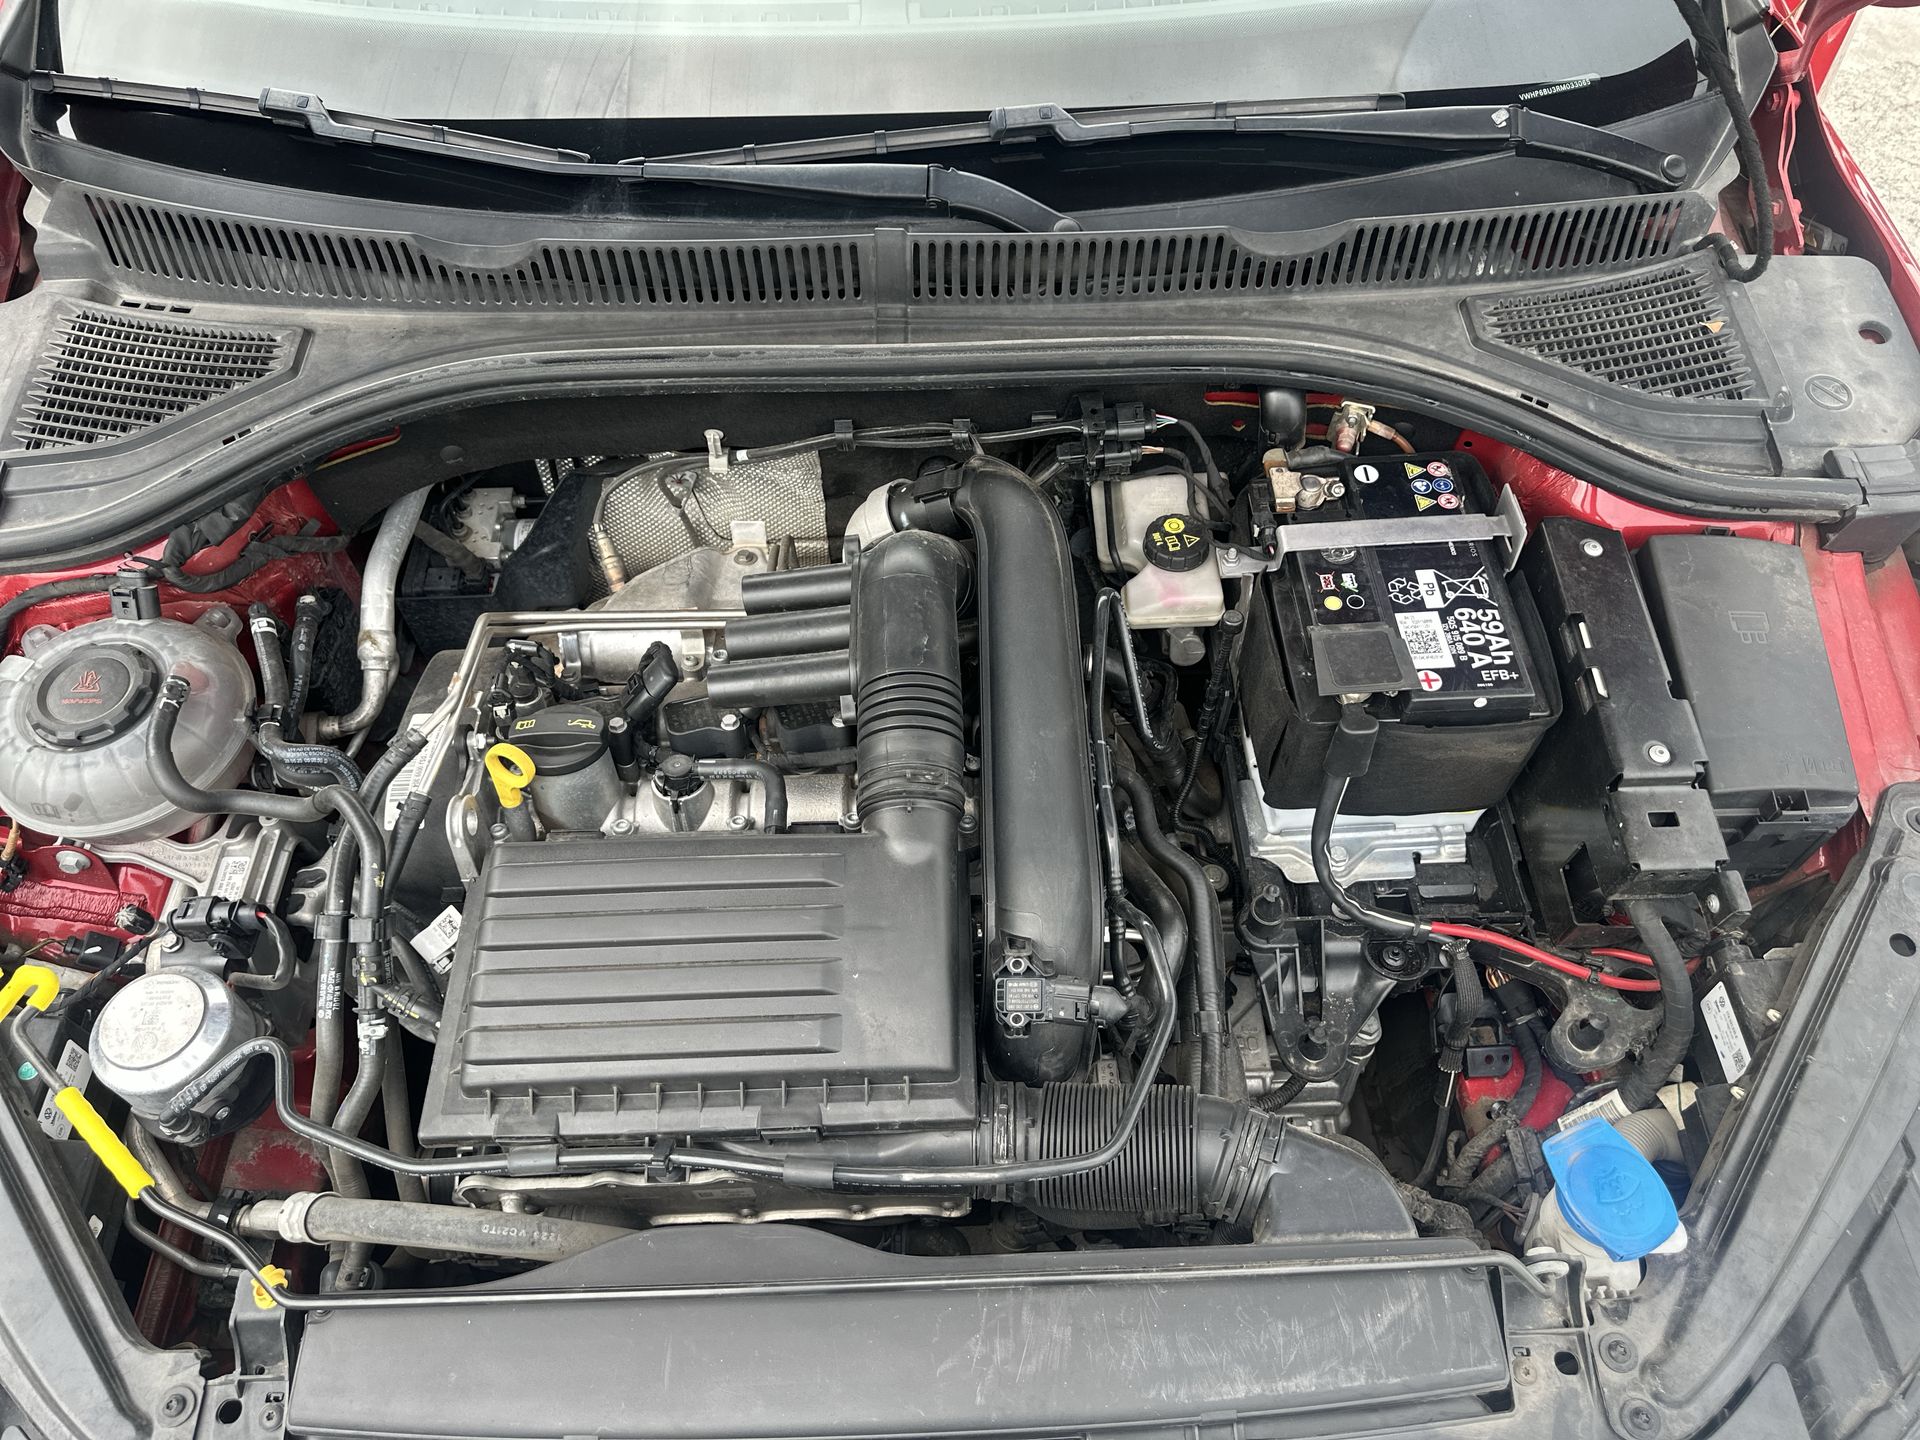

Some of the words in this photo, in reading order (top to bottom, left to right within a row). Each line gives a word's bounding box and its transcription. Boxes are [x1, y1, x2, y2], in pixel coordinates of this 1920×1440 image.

[1468, 541, 1478, 557] RIOS
[1423, 582, 1436, 596] Pb
[1453, 607, 1486, 646] 640
[1476, 608, 1514, 665] 59Ah
[1467, 651, 1493, 669] A
[1480, 669, 1519, 681] EFB+
